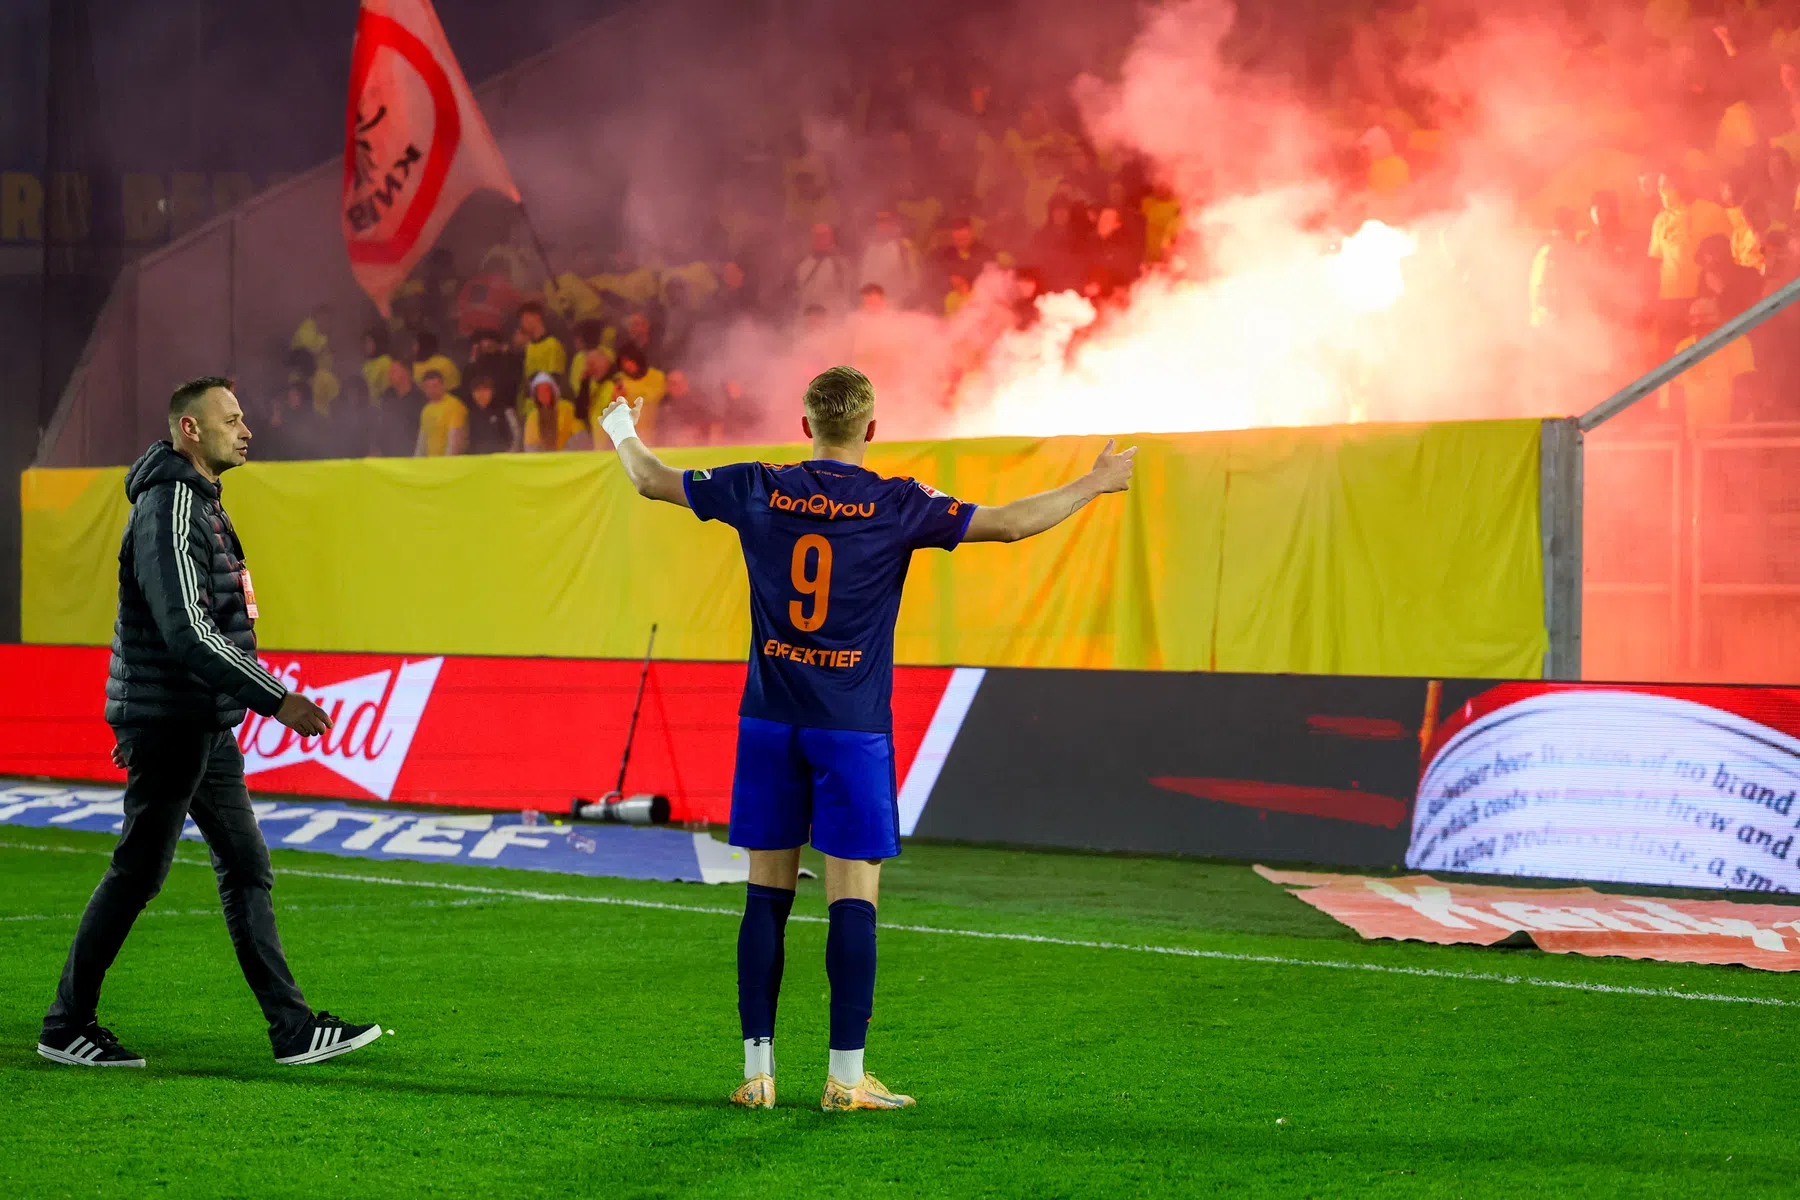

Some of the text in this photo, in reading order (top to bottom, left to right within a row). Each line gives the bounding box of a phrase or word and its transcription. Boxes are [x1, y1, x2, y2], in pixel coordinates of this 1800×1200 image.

[769, 489, 875, 520] tanQyou
[788, 533, 833, 632] 9
[1713, 762, 1797, 817] brand
[0, 787, 572, 859] FFTIEF
[1737, 824, 1794, 860] and
[1708, 857, 1726, 878] a
